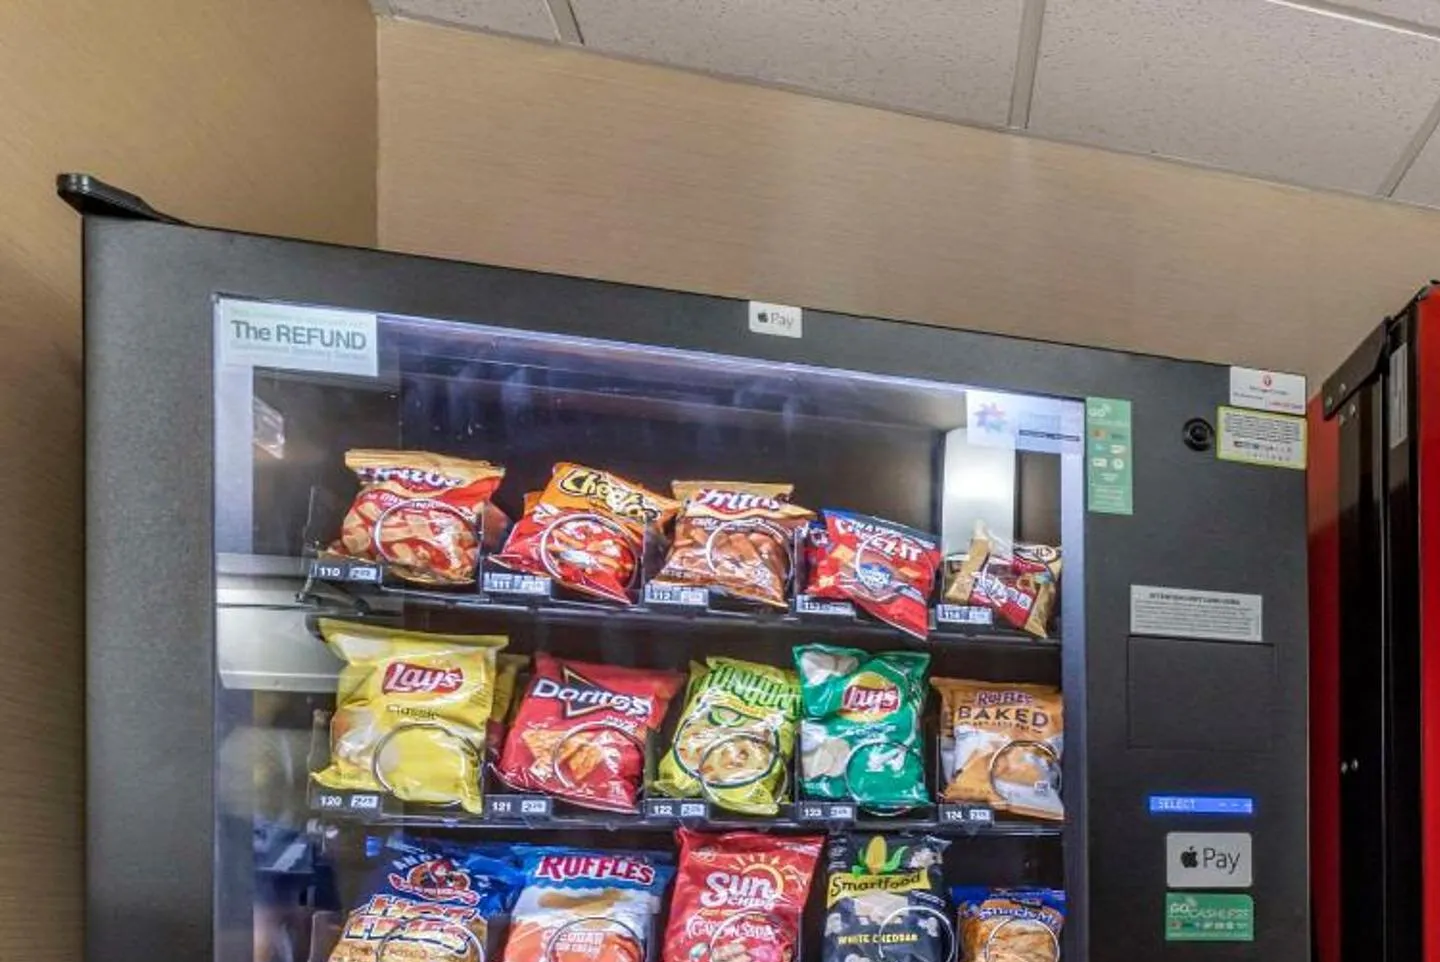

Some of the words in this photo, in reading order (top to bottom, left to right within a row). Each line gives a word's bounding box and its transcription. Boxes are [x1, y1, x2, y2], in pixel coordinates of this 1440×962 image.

[769, 311, 795, 330] Pay
[230, 319, 272, 343] The
[275, 324, 368, 352] REFUND
[384, 662, 464, 694] Lay's
[531, 678, 653, 718] Doritos
[956, 705, 1050, 728] BAKED
[320, 796, 343, 808] 120
[491, 800, 512, 812] 121
[536, 854, 656, 886] RUFFLES
[1202, 847, 1241, 875] Pay
[701, 872, 776, 907] Sun
[829, 873, 924, 897] Smartfood
